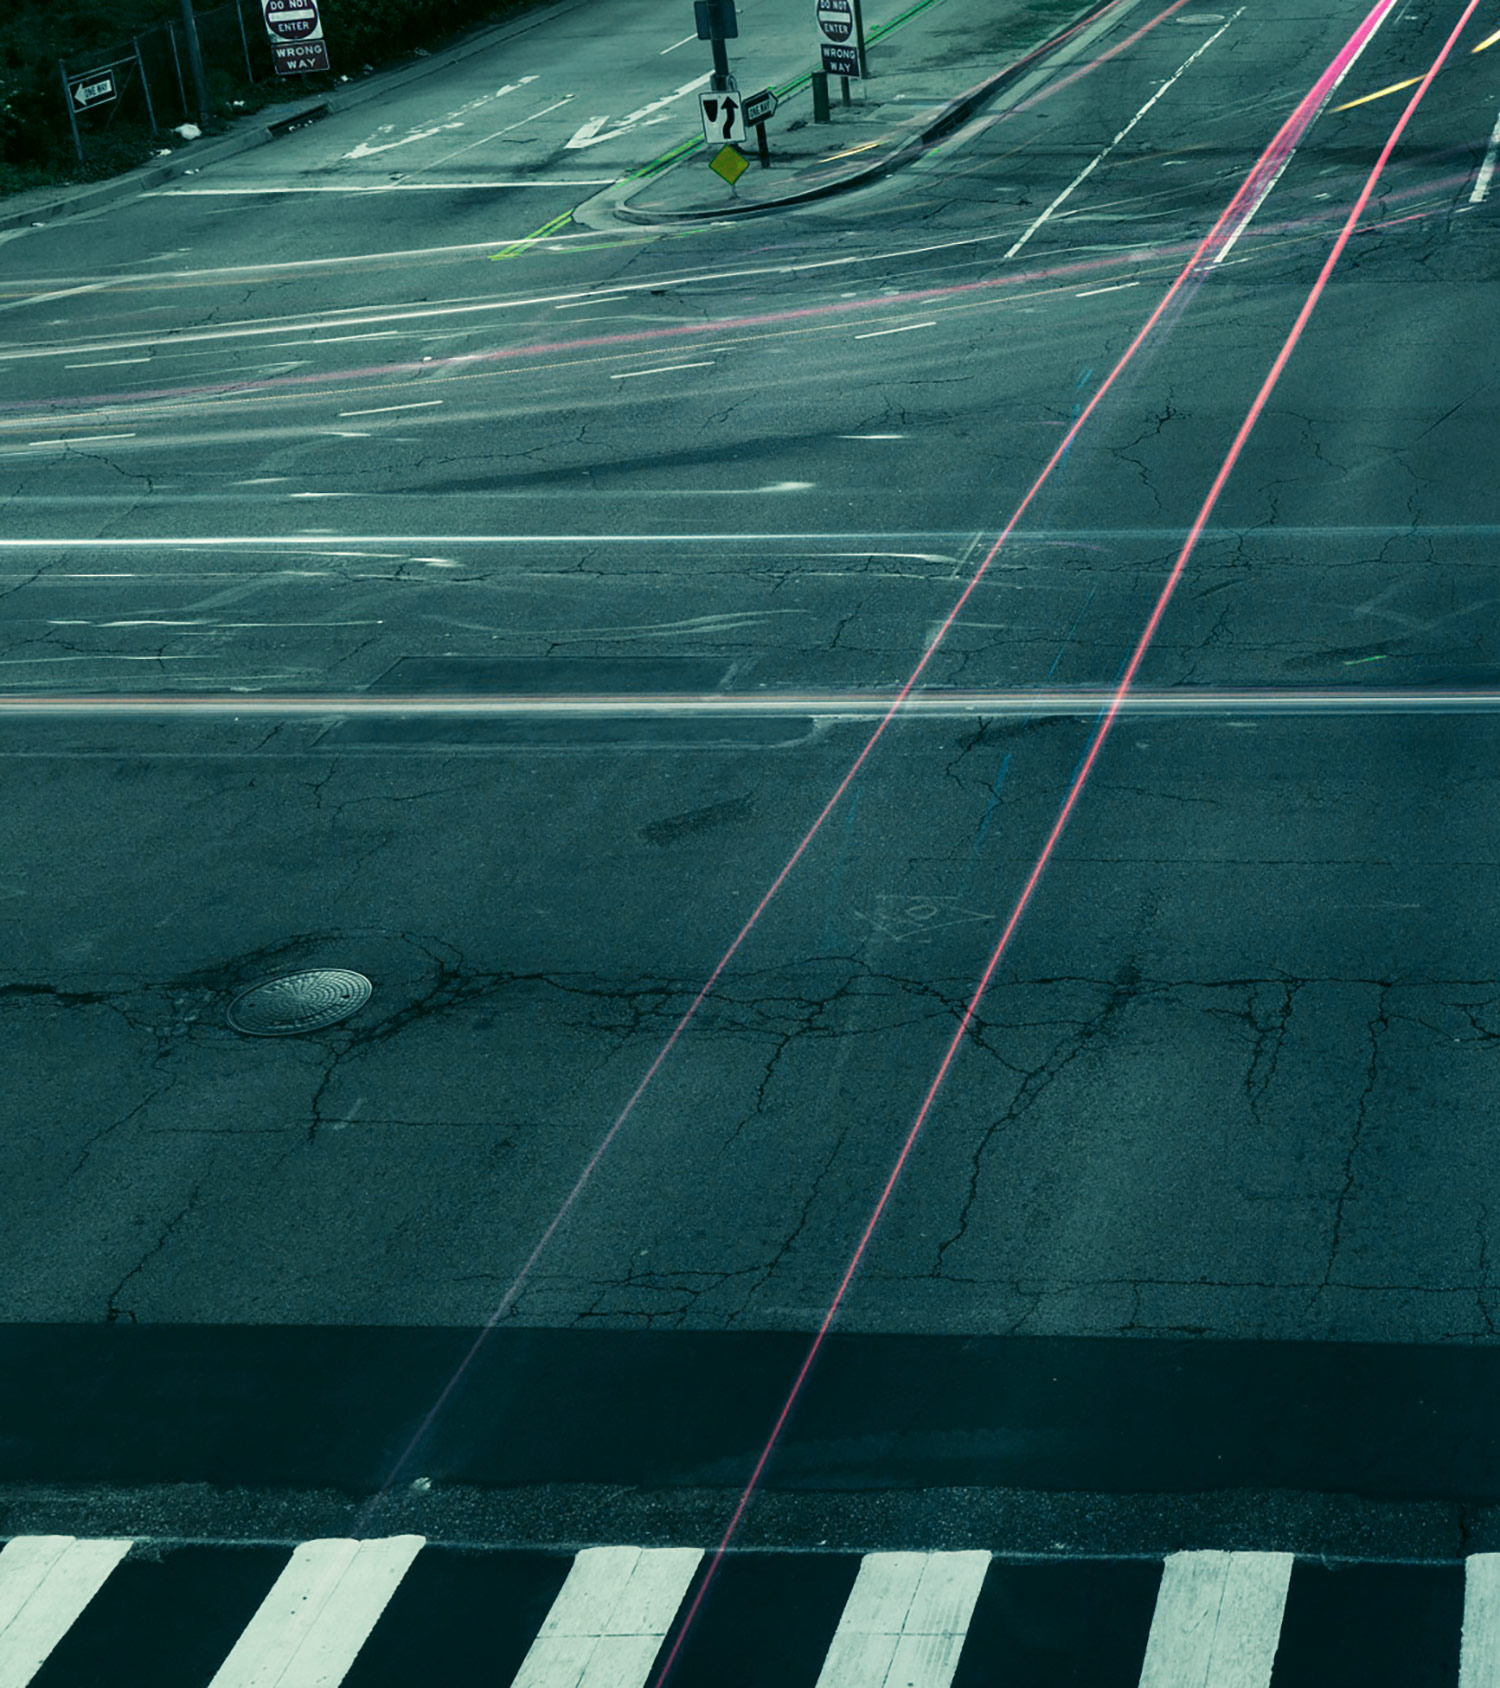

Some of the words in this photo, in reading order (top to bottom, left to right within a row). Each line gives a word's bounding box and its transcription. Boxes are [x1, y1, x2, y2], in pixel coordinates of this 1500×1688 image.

[270, 0, 285, 10] DO
[289, 0, 308, 9] NOT
[820, 0, 831, 9] DO
[832, 0, 847, 10] NOT
[278, 21, 310, 32] ENTER
[824, 23, 849, 34] ENTER
[276, 44, 322, 58] WRONG
[823, 47, 856, 60] WRONG
[286, 58, 316, 70] WAY
[830, 62, 851, 72] WAY
[84, 86, 96, 98] ONE
[96, 82, 108, 94] WAY
[749, 105, 760, 118] ONE
[760, 100, 771, 112] WAY
